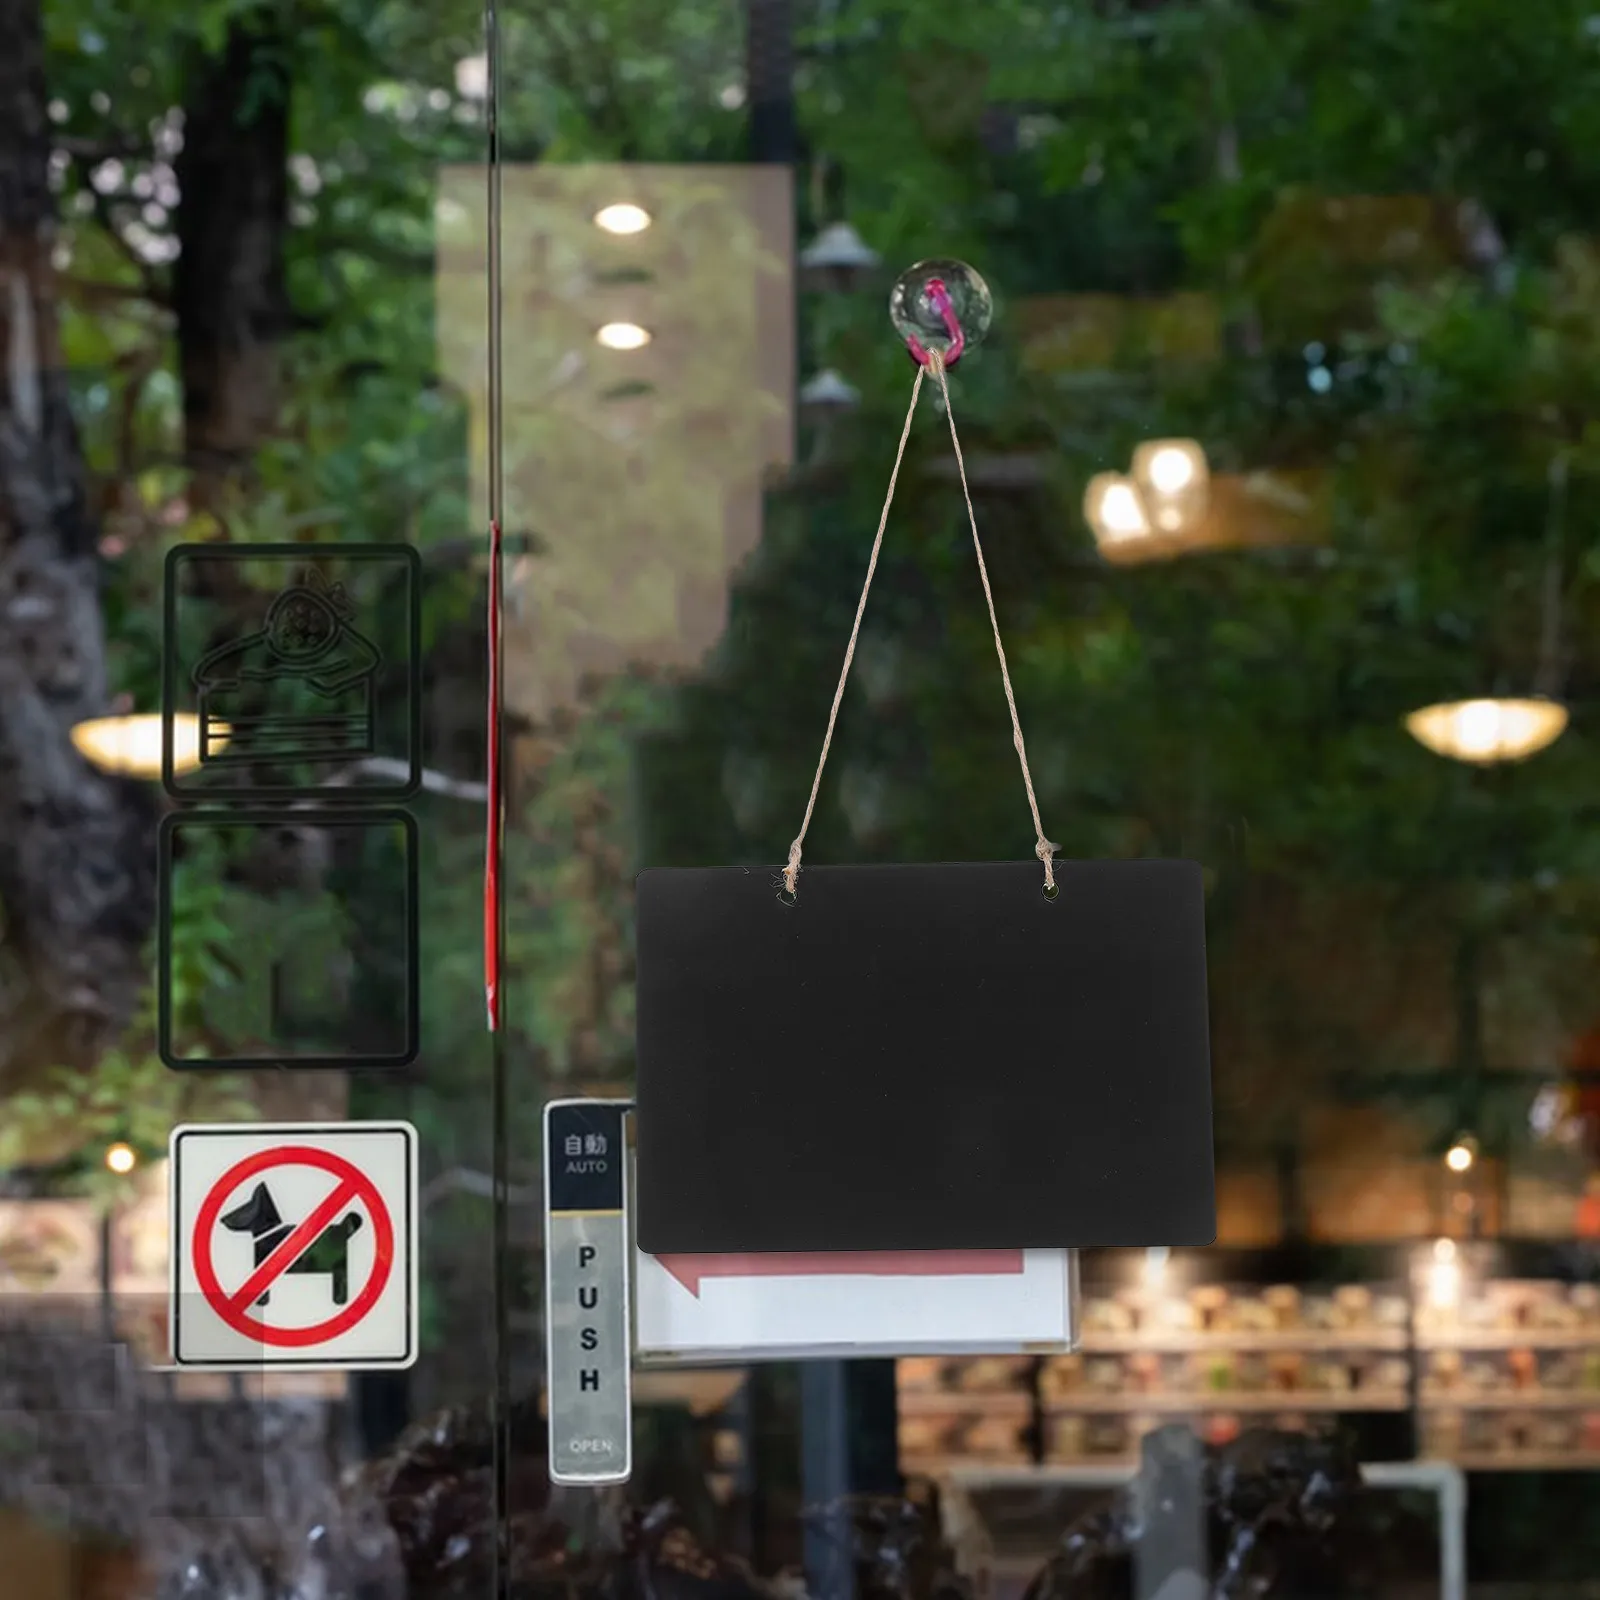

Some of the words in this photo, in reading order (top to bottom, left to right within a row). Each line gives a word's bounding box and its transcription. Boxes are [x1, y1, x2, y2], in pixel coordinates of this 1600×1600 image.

[565, 1134, 607, 1155] 自動
[566, 1161, 607, 1173] AUTO
[579, 1246, 599, 1391] PUSH
[570, 1440, 612, 1453] OPEN
